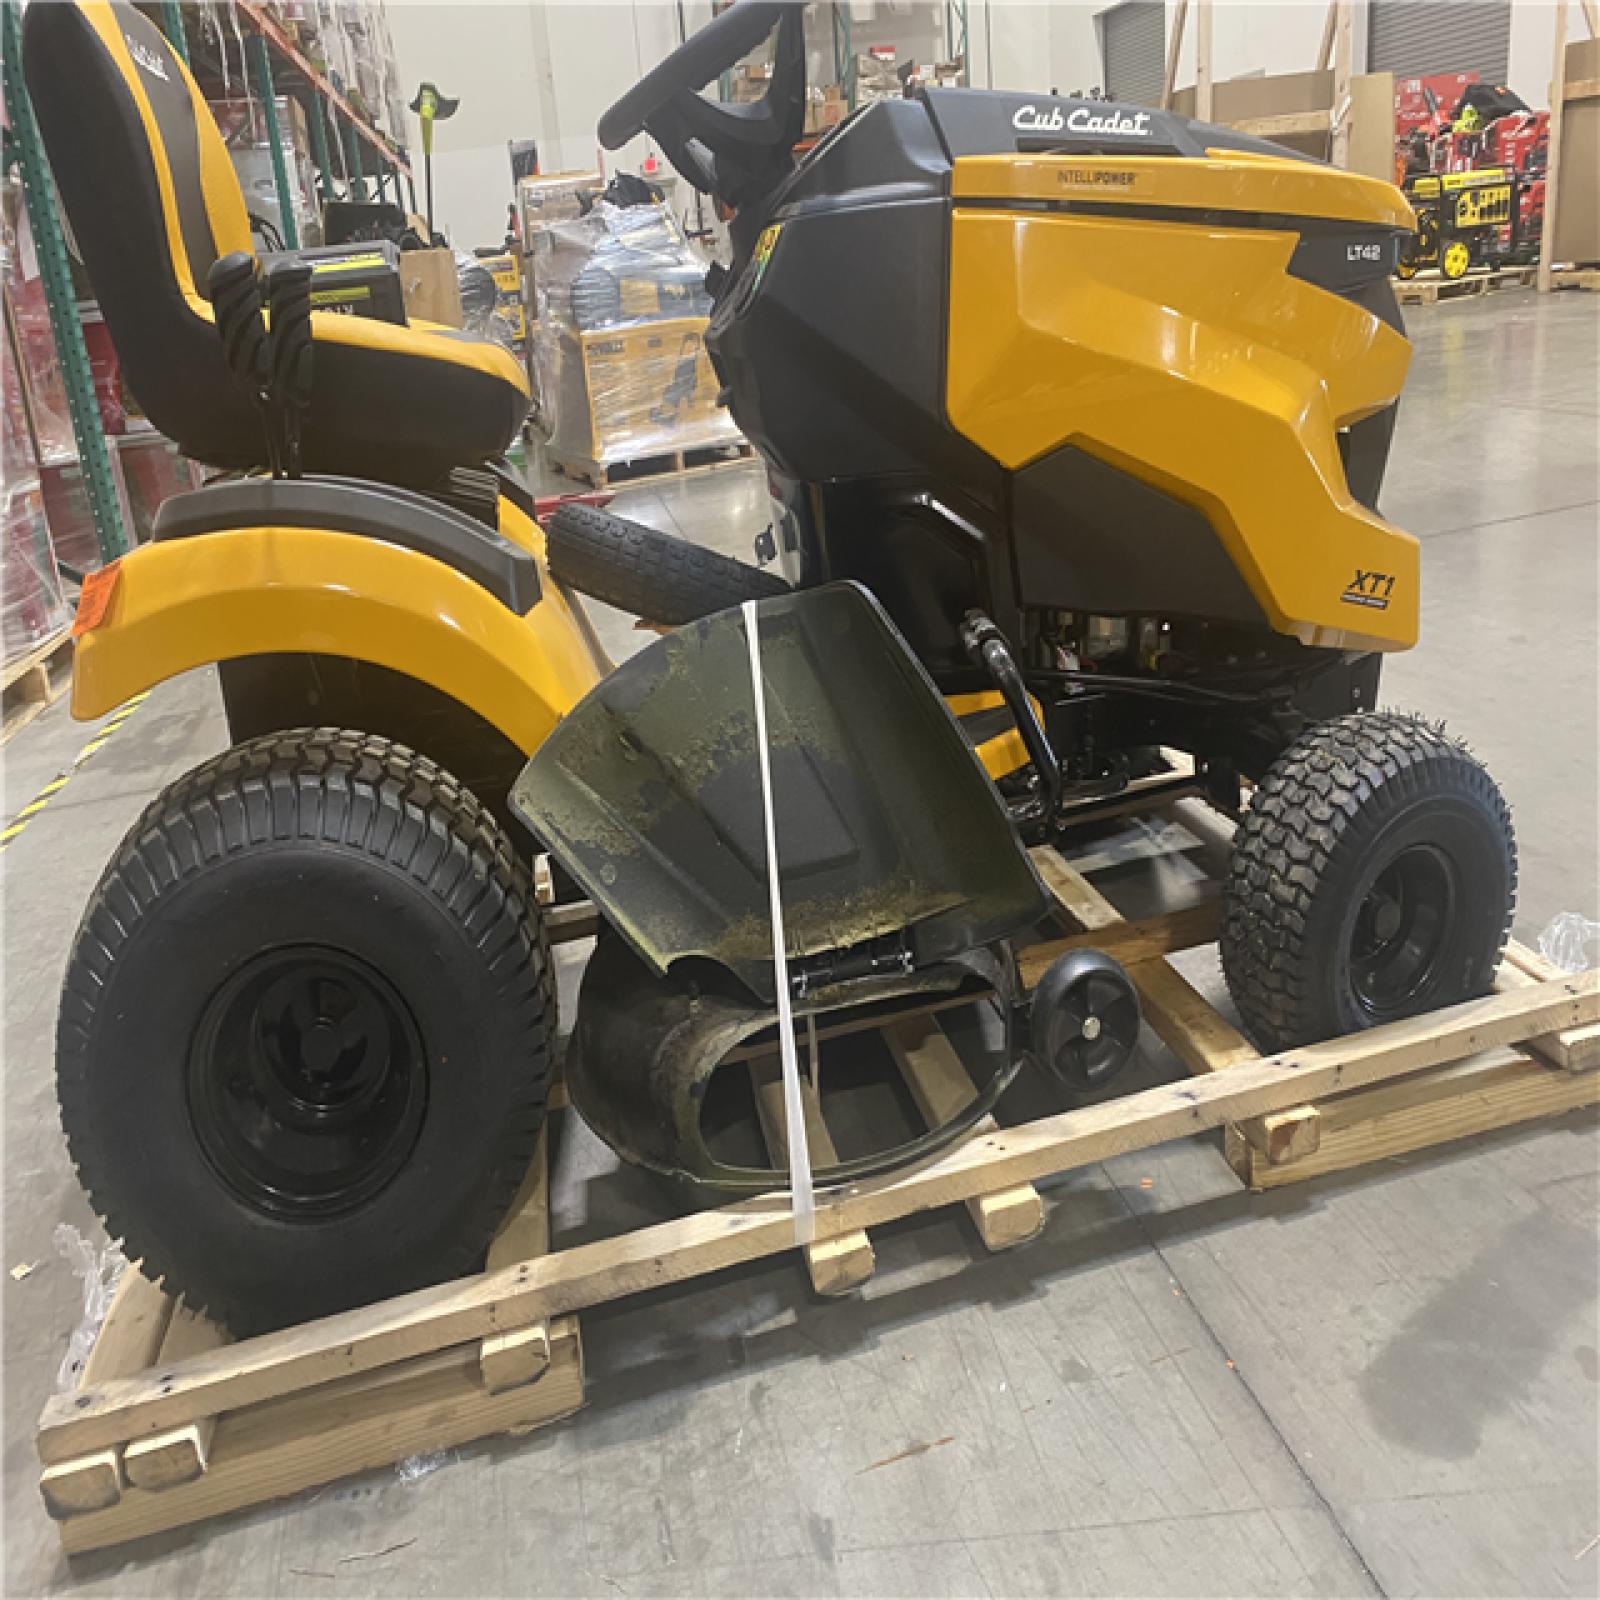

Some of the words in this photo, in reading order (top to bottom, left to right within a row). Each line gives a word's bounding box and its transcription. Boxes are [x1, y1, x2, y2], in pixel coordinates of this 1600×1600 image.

[1012, 104, 1063, 131] Cub
[1066, 107, 1152, 136] Cadet
[1347, 569, 1395, 596] XT1
